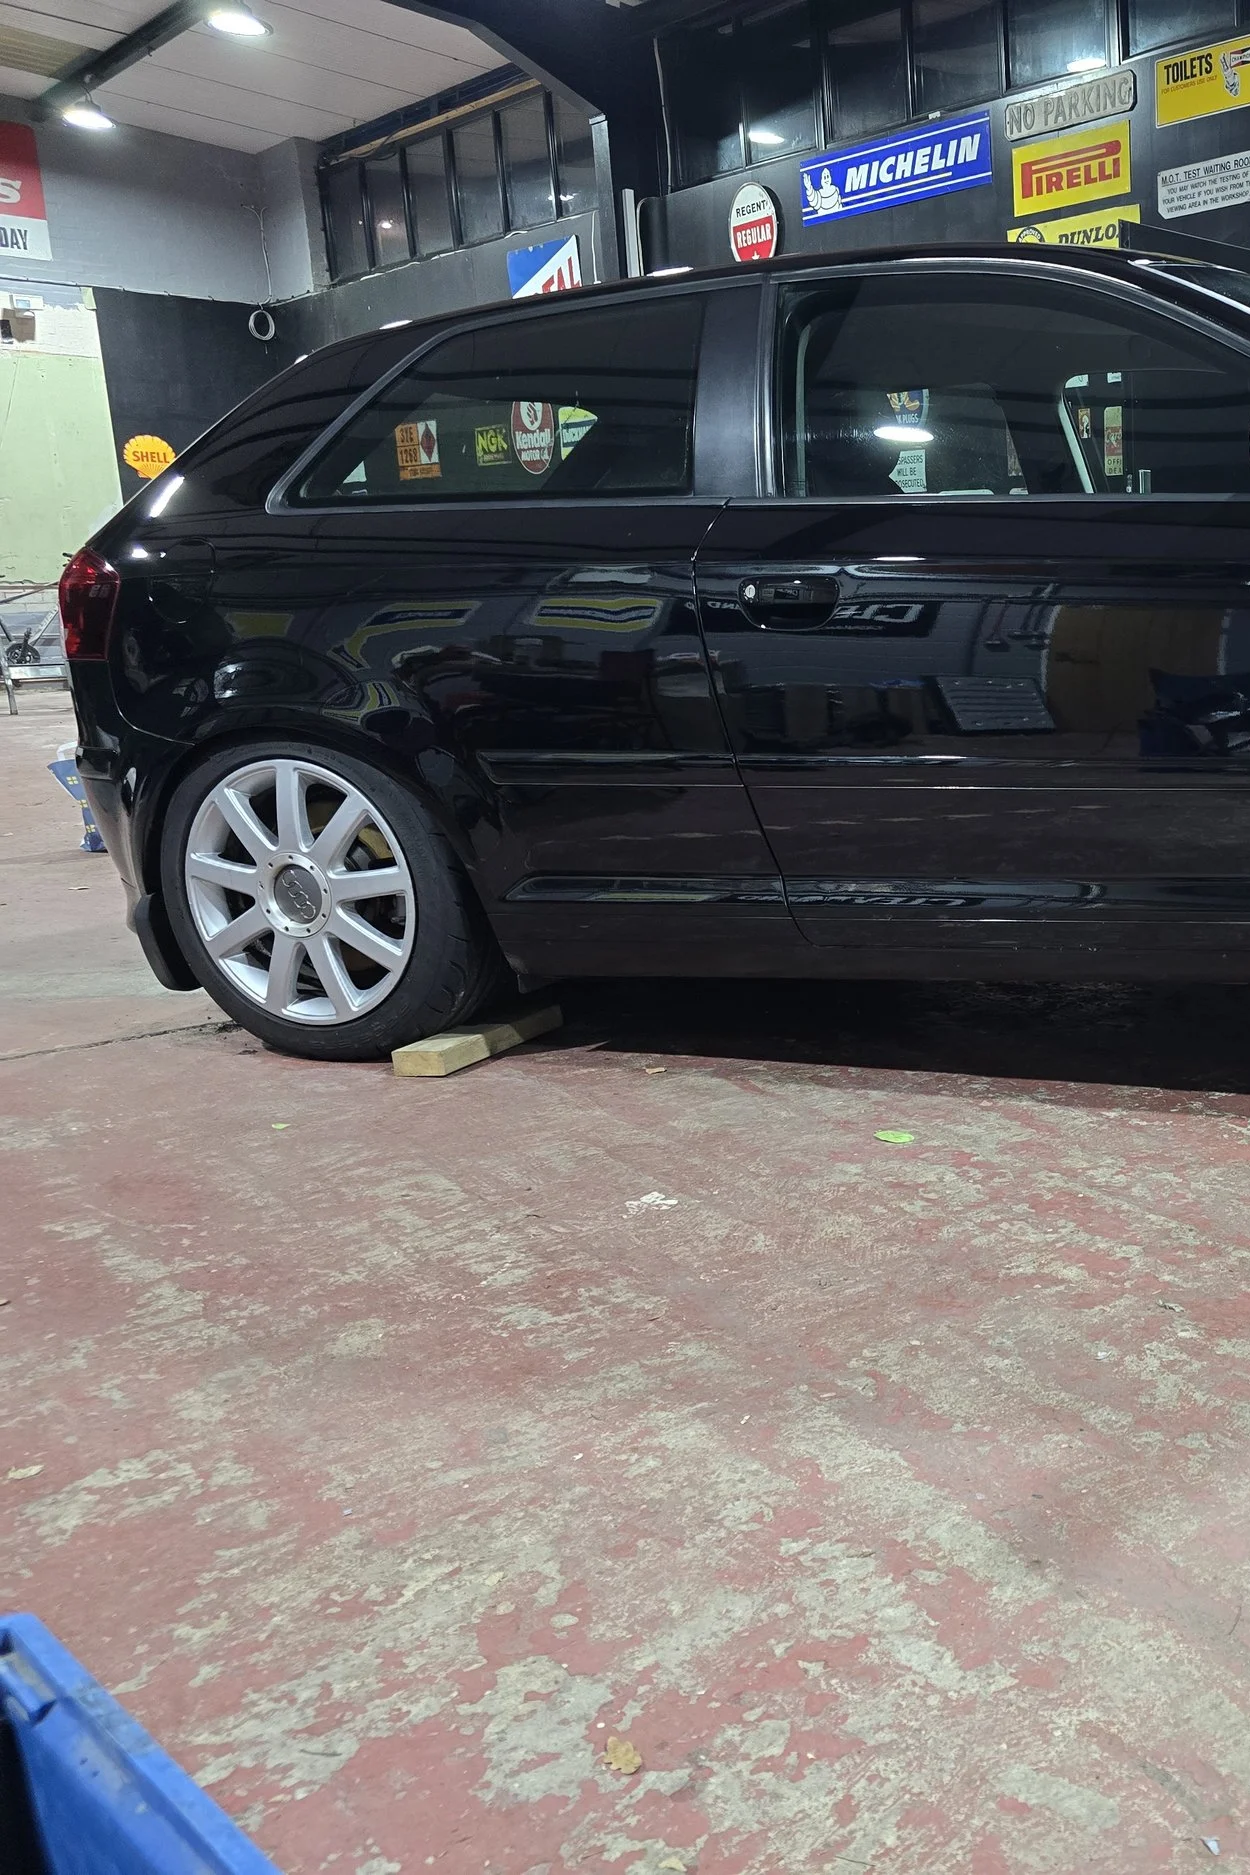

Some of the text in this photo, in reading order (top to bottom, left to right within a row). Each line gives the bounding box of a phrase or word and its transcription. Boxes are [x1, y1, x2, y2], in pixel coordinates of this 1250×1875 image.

[1164, 53, 1213, 85] TOILETS
[1161, 75, 1218, 95] FOR CUSTOMERS USE ONLY
[1009, 77, 1132, 136] NO PARKING
[844, 133, 981, 193] MICHELIN
[1020, 140, 1122, 199] PIRELLI
[1161, 172, 1181, 185] M.O.T.
[1184, 168, 1201, 180] TEST
[1203, 161, 1231, 175] WAITING
[1162, 197, 1176, 206] YOUR
[1177, 192, 1196, 203] VEHICLE
[1204, 188, 1214, 196] YOU
[1215, 185, 1228, 194] WISH
[1229, 181, 1244, 190] FROM
[1167, 170, 1250, 195] YOU MAY WATCH THE TESTING OF
[736, 199, 767, 218] REGENT
[1166, 204, 1187, 214] VIEWING
[1188, 201, 1201, 209] AREA
[1209, 196, 1220, 205] THE
[736, 222, 772, 249] REGULAR
[1058, 223, 1120, 245] DUNLO
[902, 413, 919, 424] PLUGS
[477, 429, 508, 453] NGK
[515, 428, 551, 450] Kendall
[132, 450, 170, 464] SHELL
[521, 449, 540, 462] MOTOR
[910, 467, 917, 476] BE
